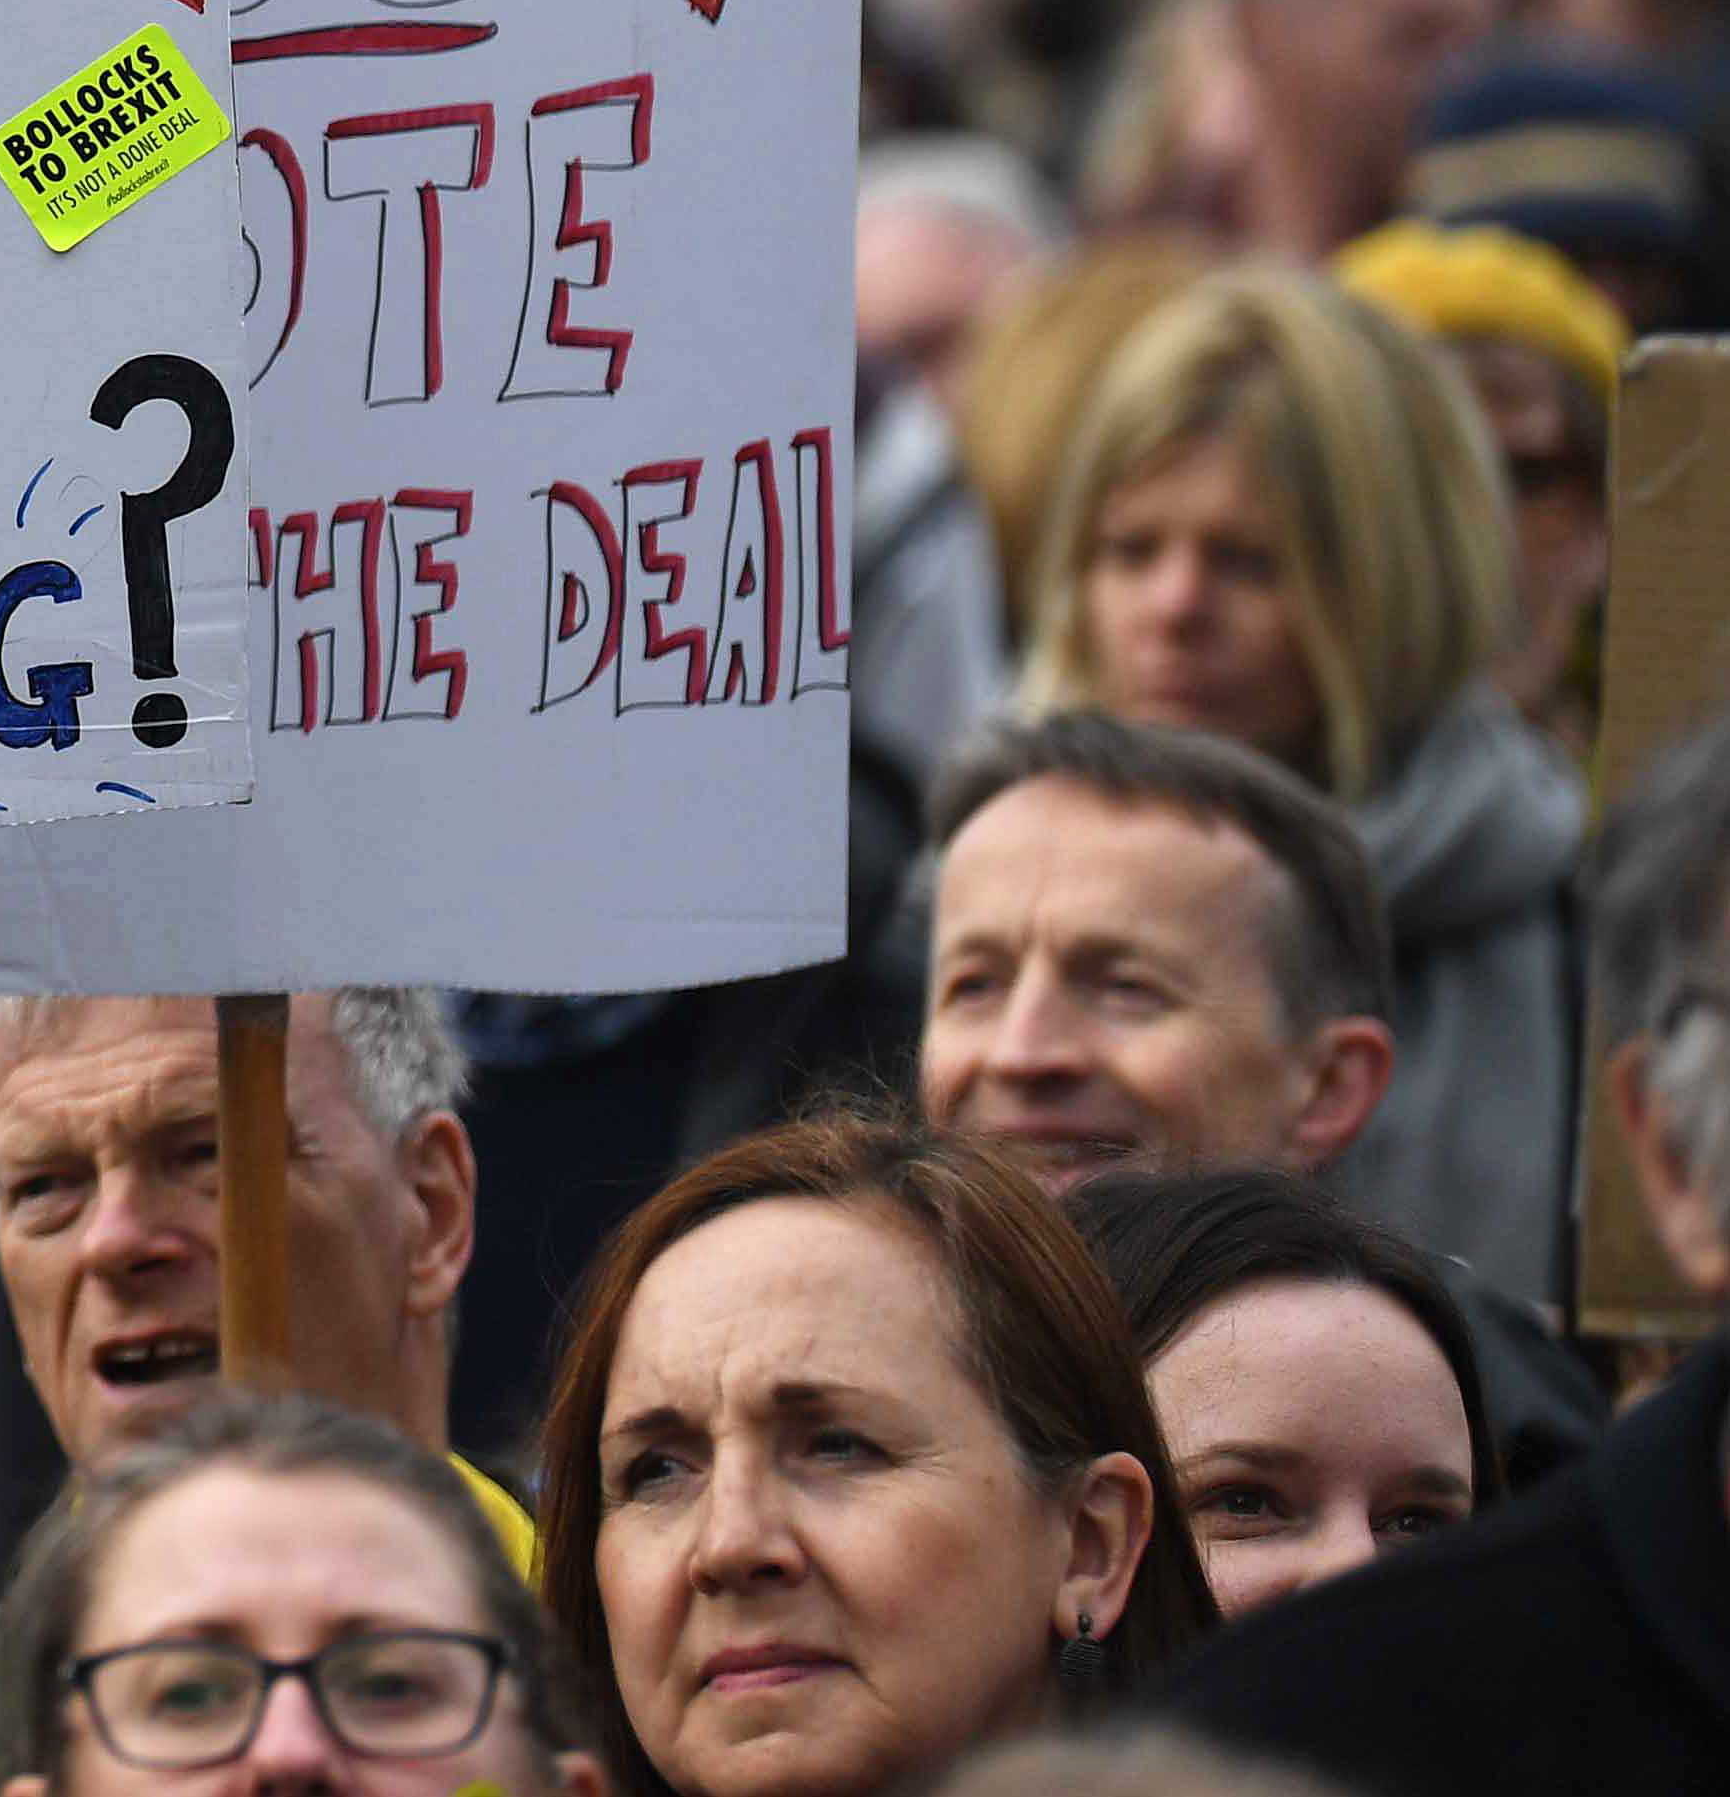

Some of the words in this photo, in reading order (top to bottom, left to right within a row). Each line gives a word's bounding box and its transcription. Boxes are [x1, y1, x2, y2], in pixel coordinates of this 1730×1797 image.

[2, 44, 161, 167] BOLLOCKS
[19, 152, 68, 196] TO
[67, 70, 182, 164] BREXIT
[45, 189, 78, 220] IT'S
[73, 168, 108, 197] NOT
[105, 161, 122, 181] A
[117, 130, 163, 170] DONE
[158, 107, 201, 142] DEAL
[529, 425, 851, 719] DEAL
